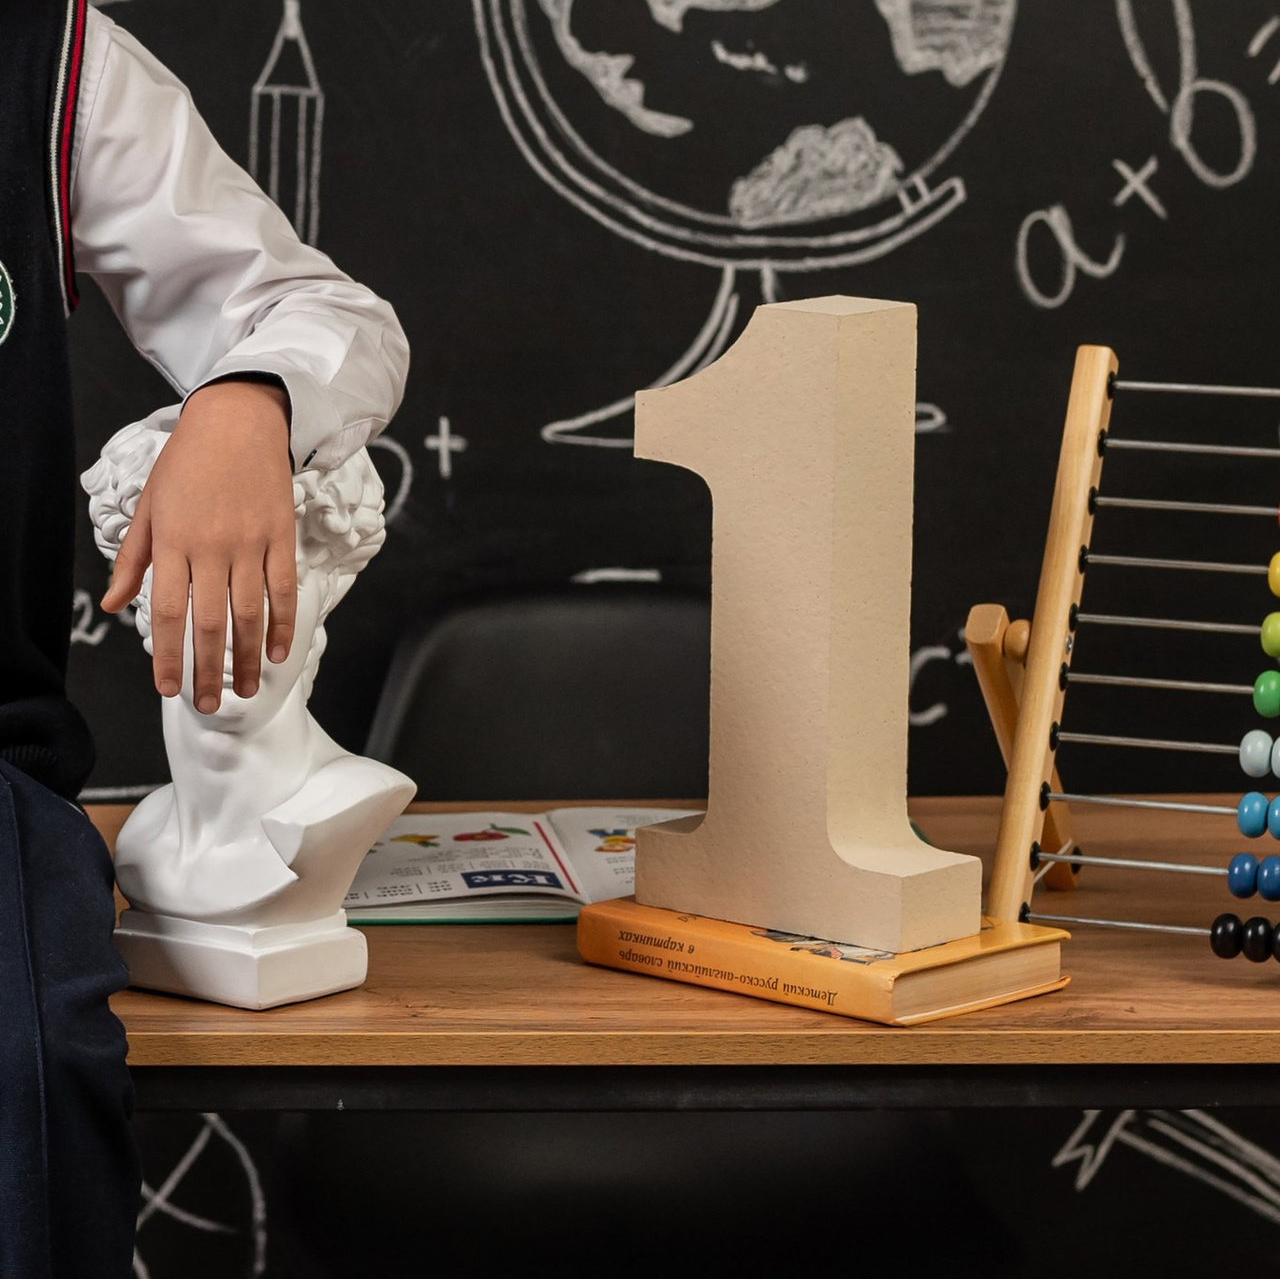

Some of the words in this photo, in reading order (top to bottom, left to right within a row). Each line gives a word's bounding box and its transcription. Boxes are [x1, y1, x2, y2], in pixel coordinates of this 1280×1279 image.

[617, 929, 685, 953] картинках
[688, 943, 696, 954] в
[618, 949, 664, 971] словарь
[666, 959, 779, 993] русско-английский
[782, 982, 838, 1006] Детский
